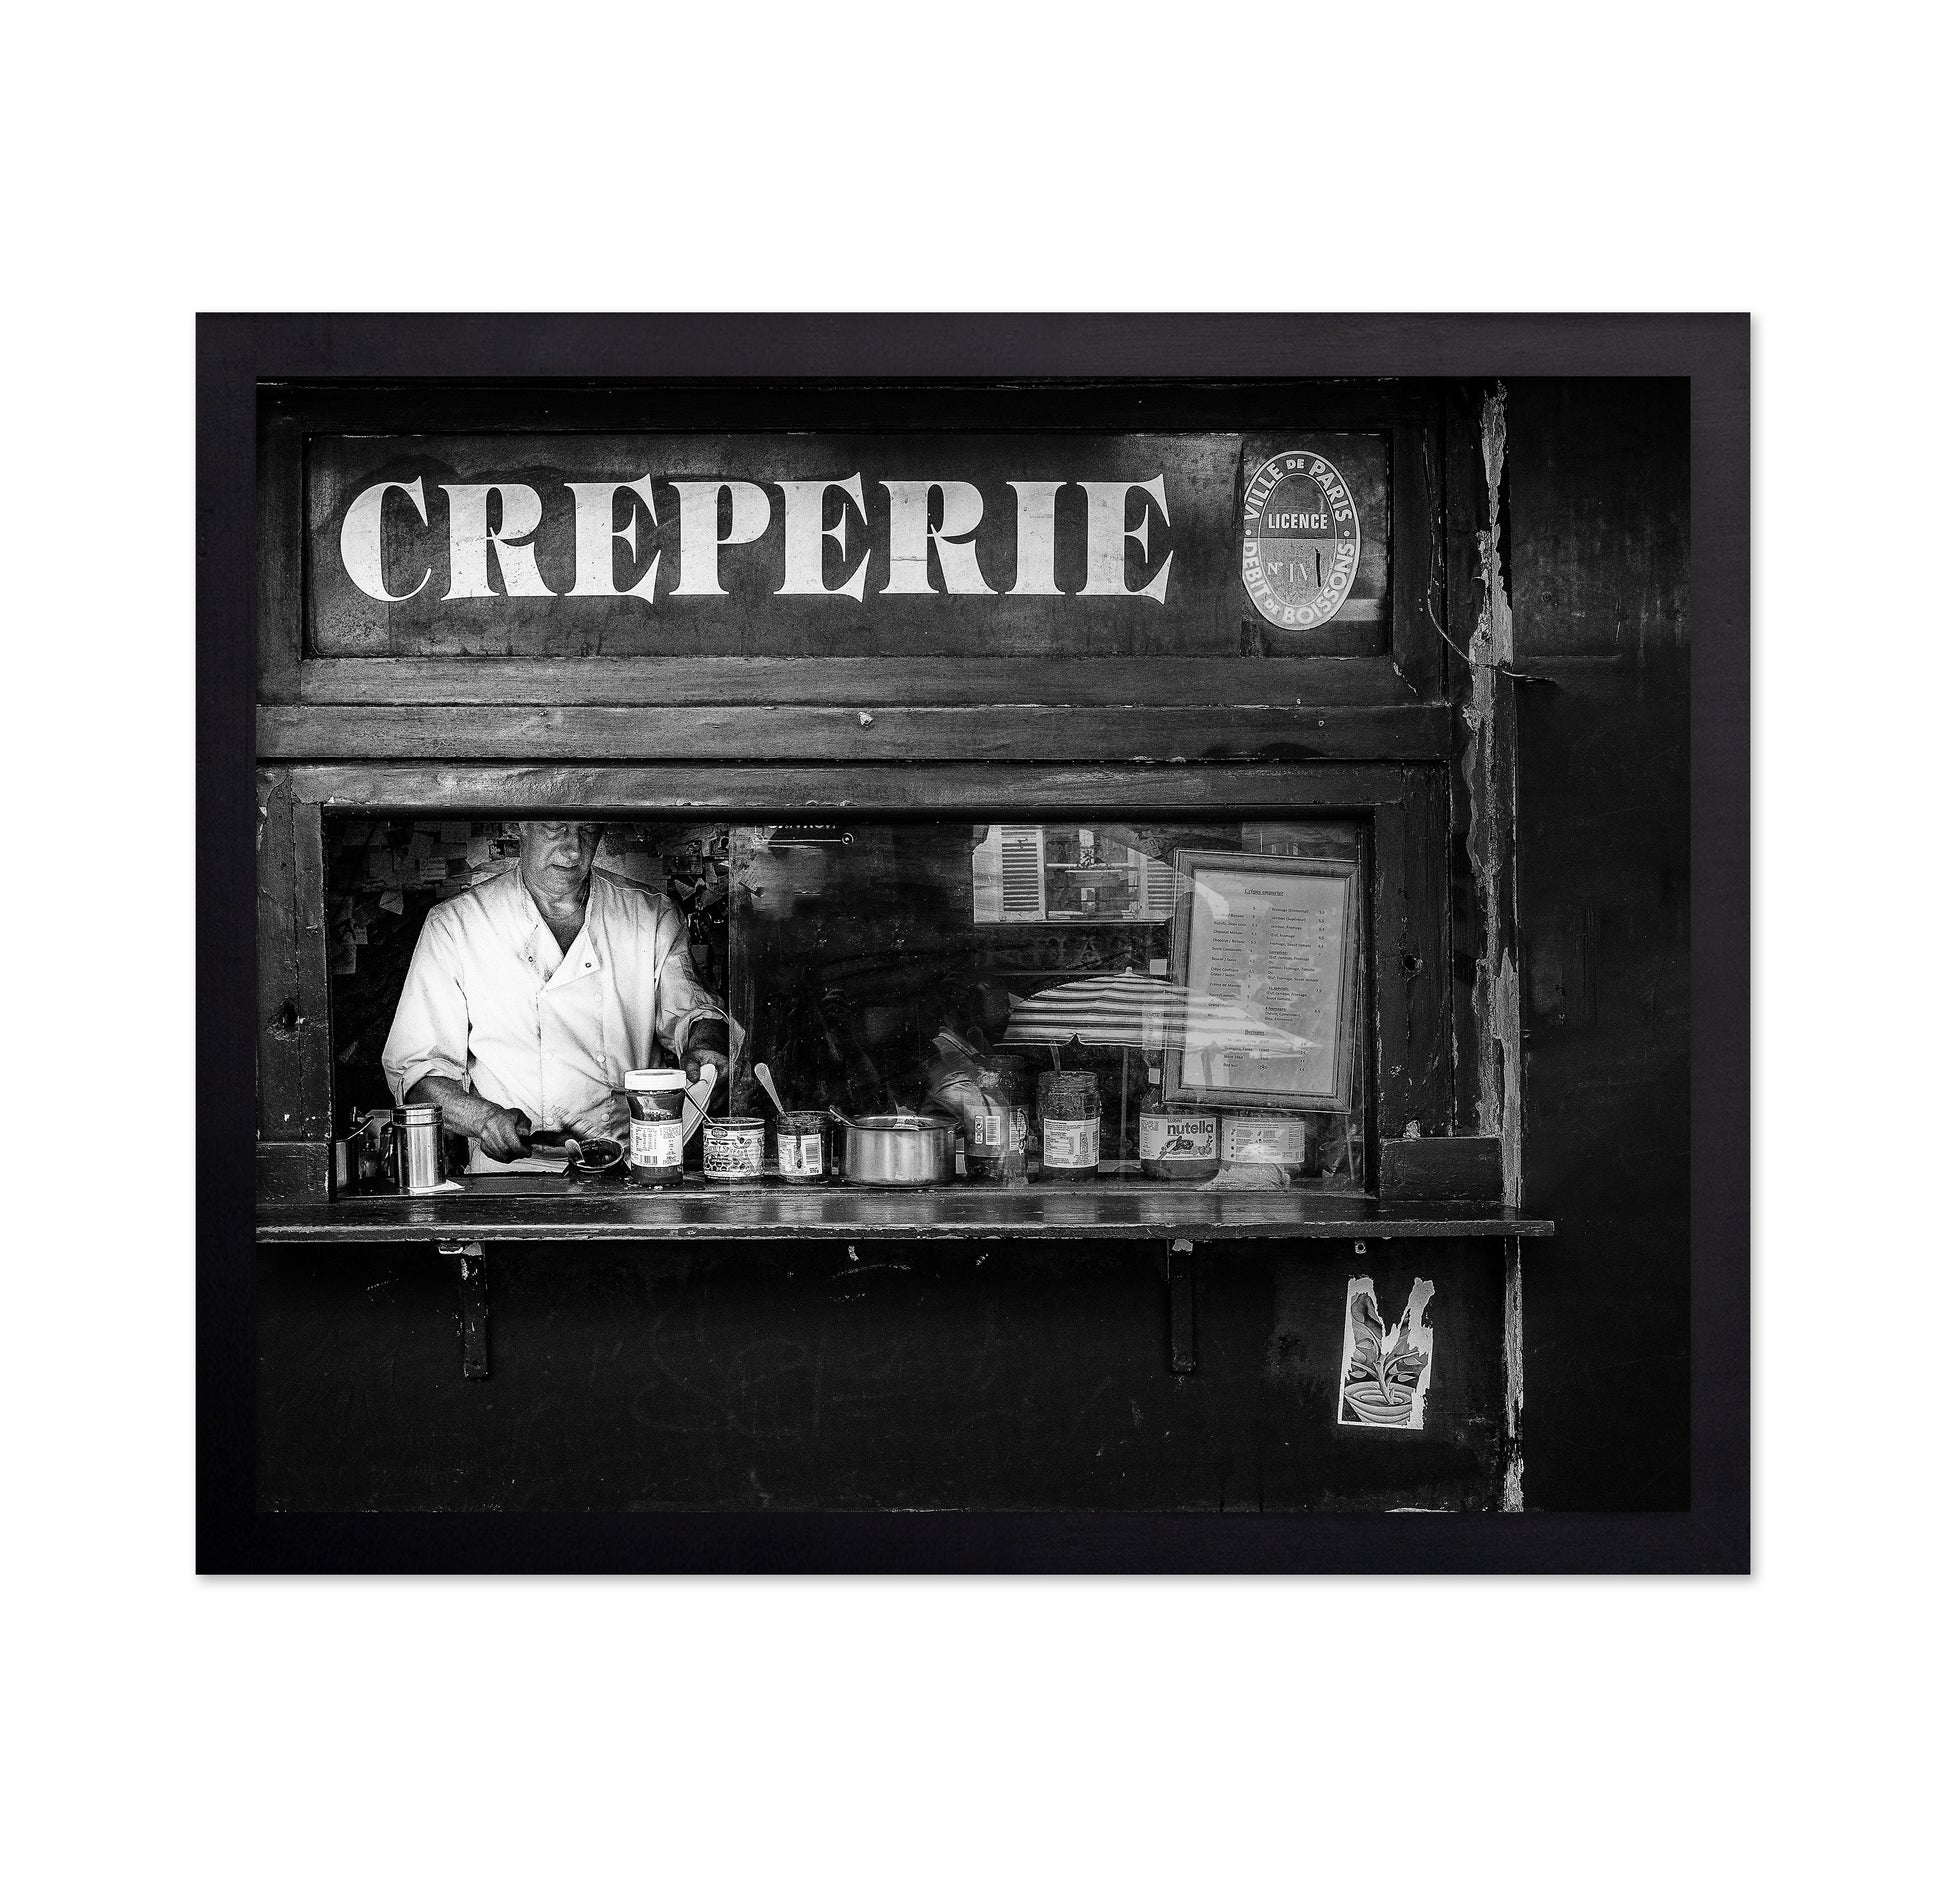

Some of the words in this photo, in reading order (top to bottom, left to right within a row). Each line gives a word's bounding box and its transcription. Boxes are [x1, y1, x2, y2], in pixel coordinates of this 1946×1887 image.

[1243, 462, 1284, 521] VILLE
[1286, 459, 1305, 470] DE
[1308, 459, 1353, 522] PARIS
[1268, 513, 1328, 530] LICENCE
[340, 472, 1174, 605] CREPERIE
[1282, 542, 1355, 625] BOISSONS
[1167, 1120, 1214, 1135] nutella
